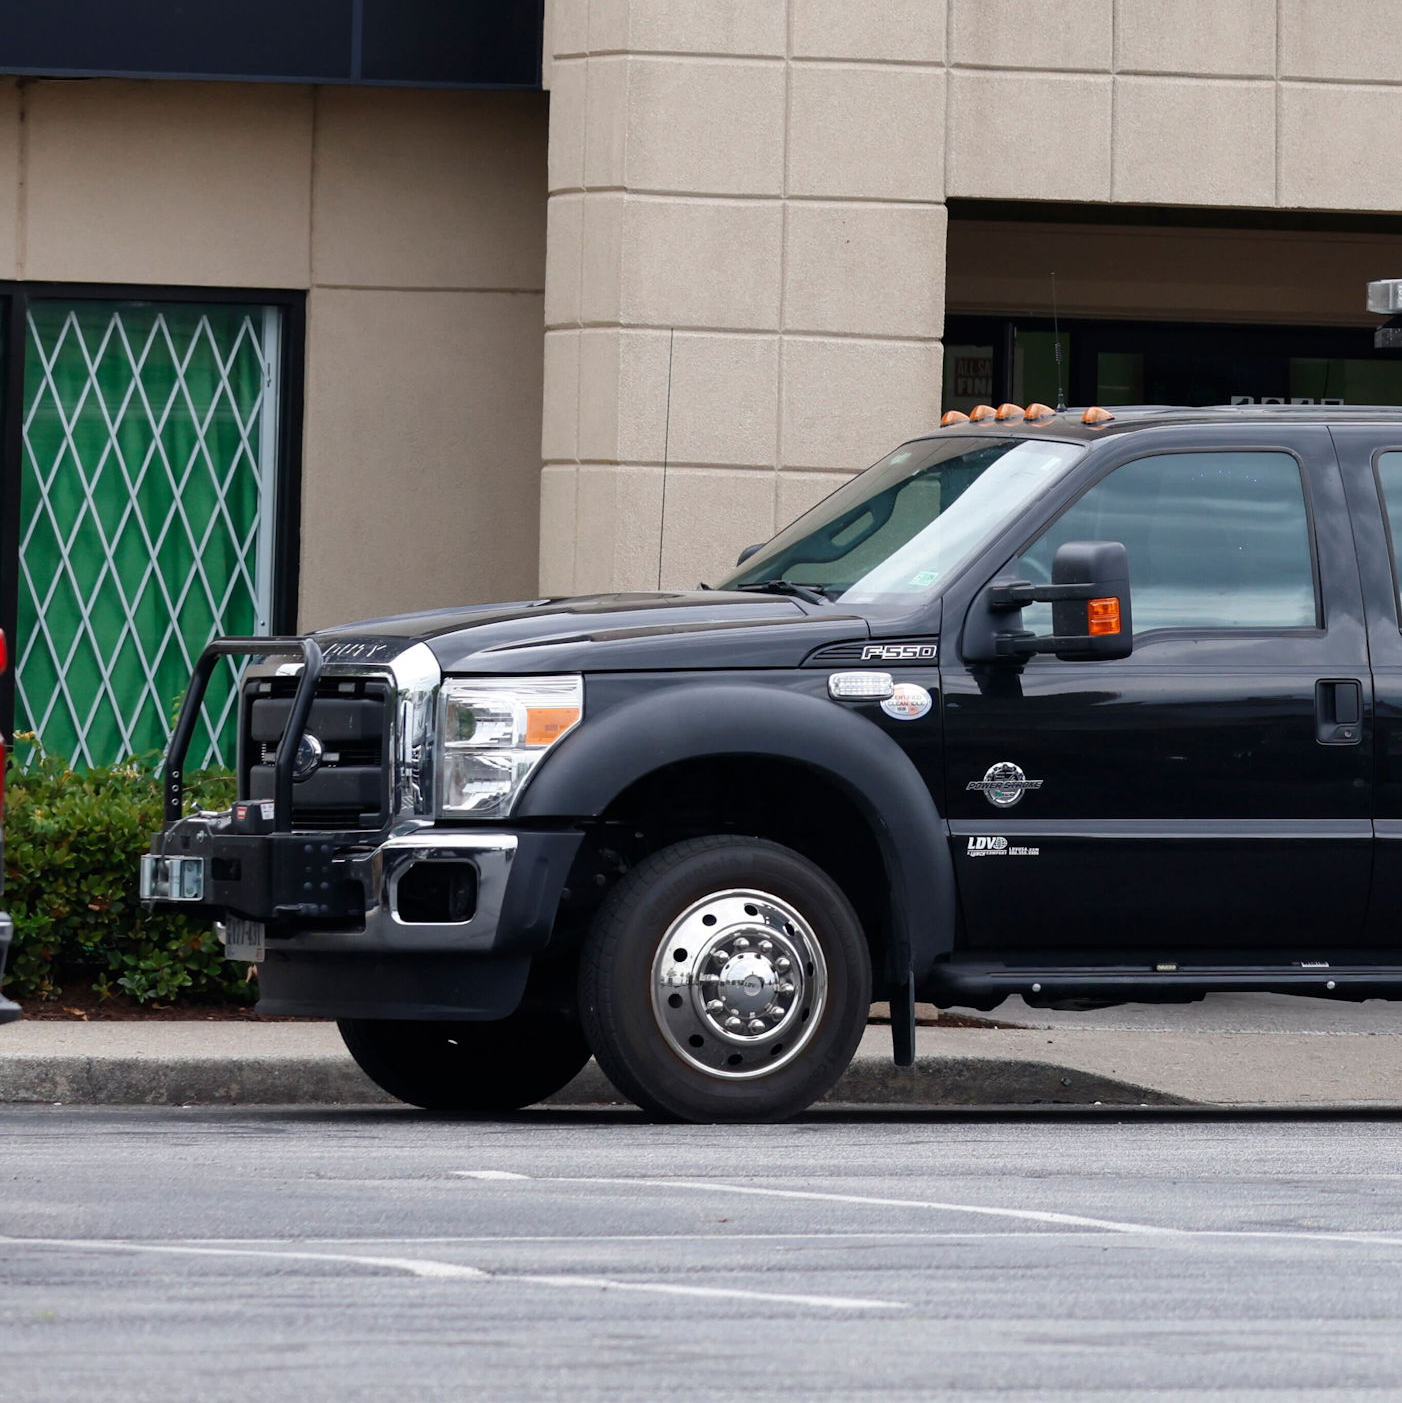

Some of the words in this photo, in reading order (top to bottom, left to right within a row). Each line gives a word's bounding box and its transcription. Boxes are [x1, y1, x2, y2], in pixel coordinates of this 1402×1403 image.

[860, 644, 938, 660] F-550
[966, 781, 1003, 791] POWER
[1002, 779, 1044, 790] STROKE
[967, 836, 997, 850] LDV
